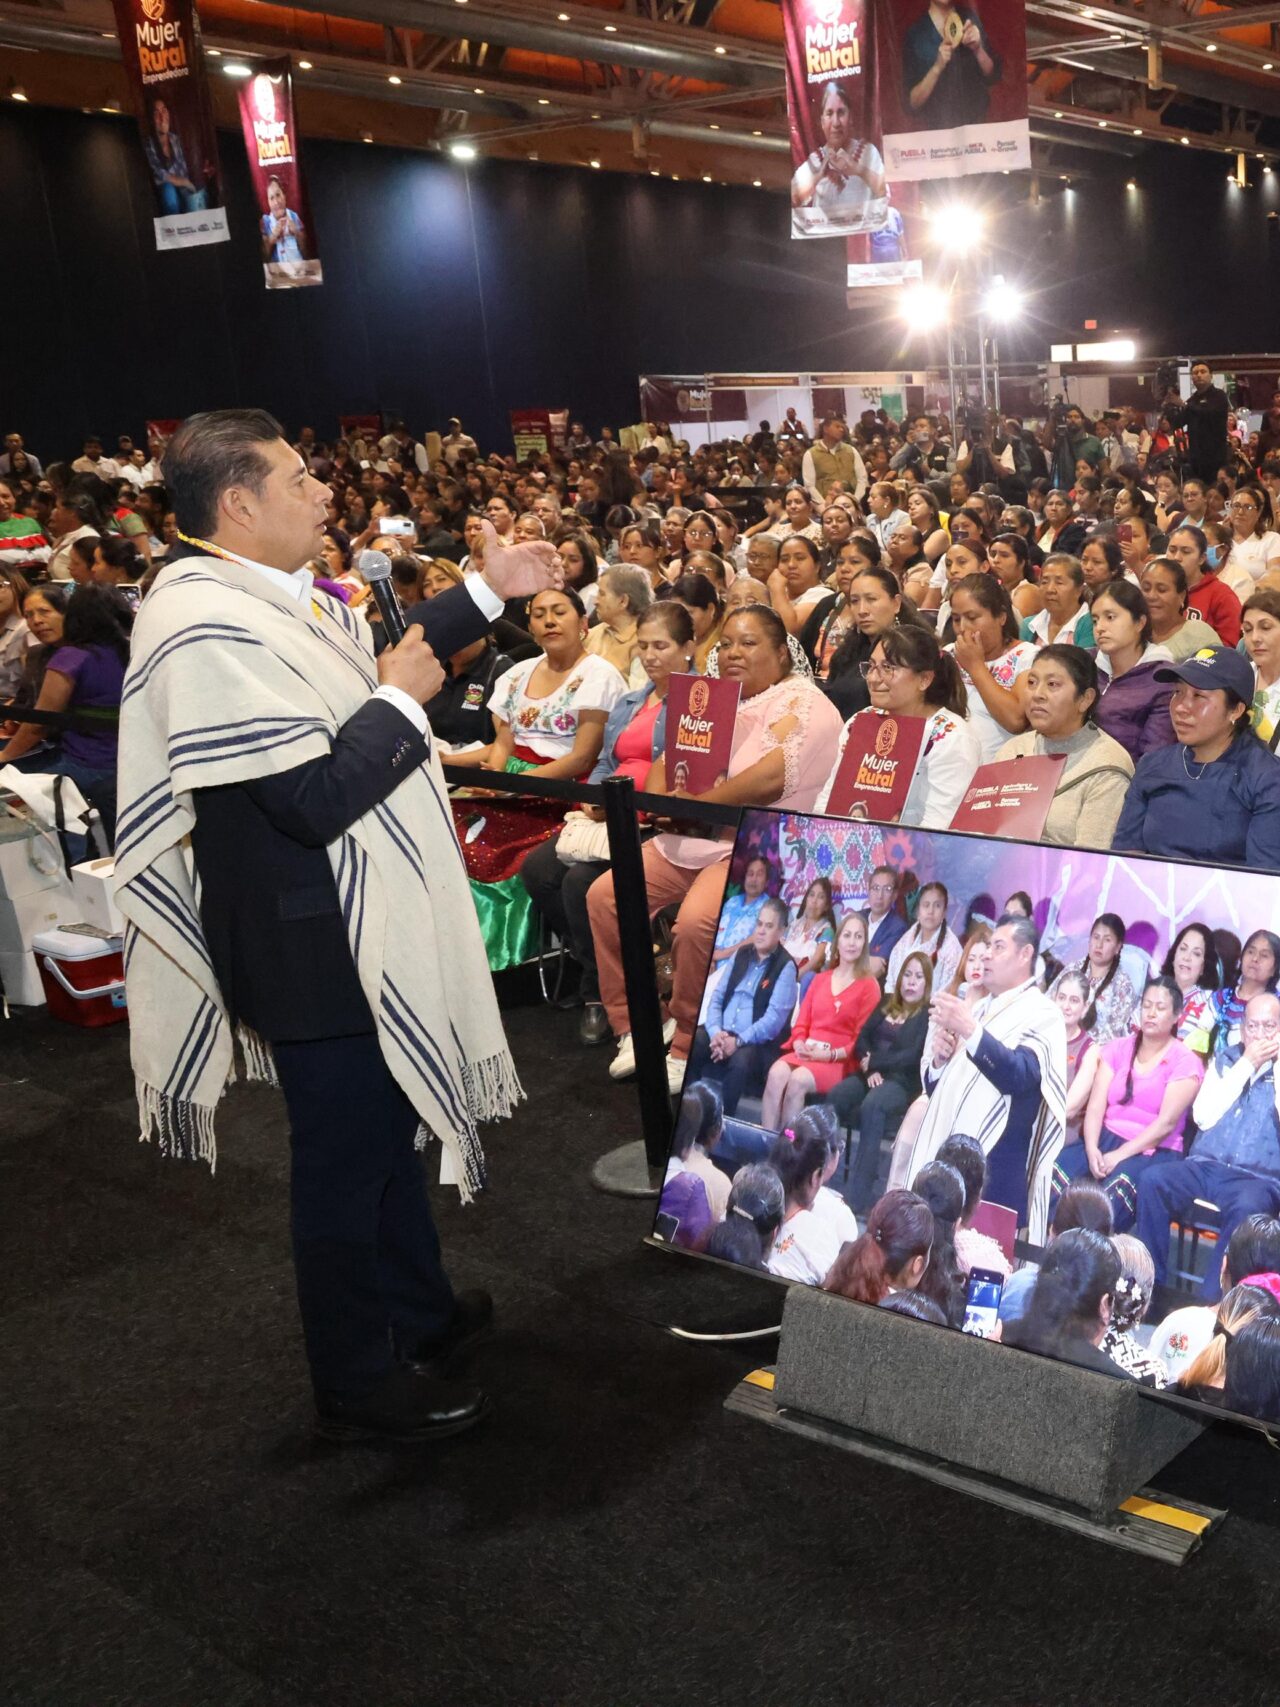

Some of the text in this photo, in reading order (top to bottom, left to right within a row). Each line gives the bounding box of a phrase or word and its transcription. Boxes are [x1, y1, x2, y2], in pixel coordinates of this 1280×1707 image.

[136, 18, 180, 49] Mujer
[806, 20, 857, 50] Mujer
[138, 37, 186, 73] Rural
[806, 38, 860, 73] Rural
[807, 66, 861, 83] Emprendedora
[257, 134, 291, 159] Rural
[900, 149, 926, 157] PUEBLA
[679, 714, 714, 733] Mujer
[677, 727, 712, 747] Rural
[860, 753, 899, 773] Mujer
[857, 767, 896, 787] Rural
[854, 782, 892, 793] Emprendedora
